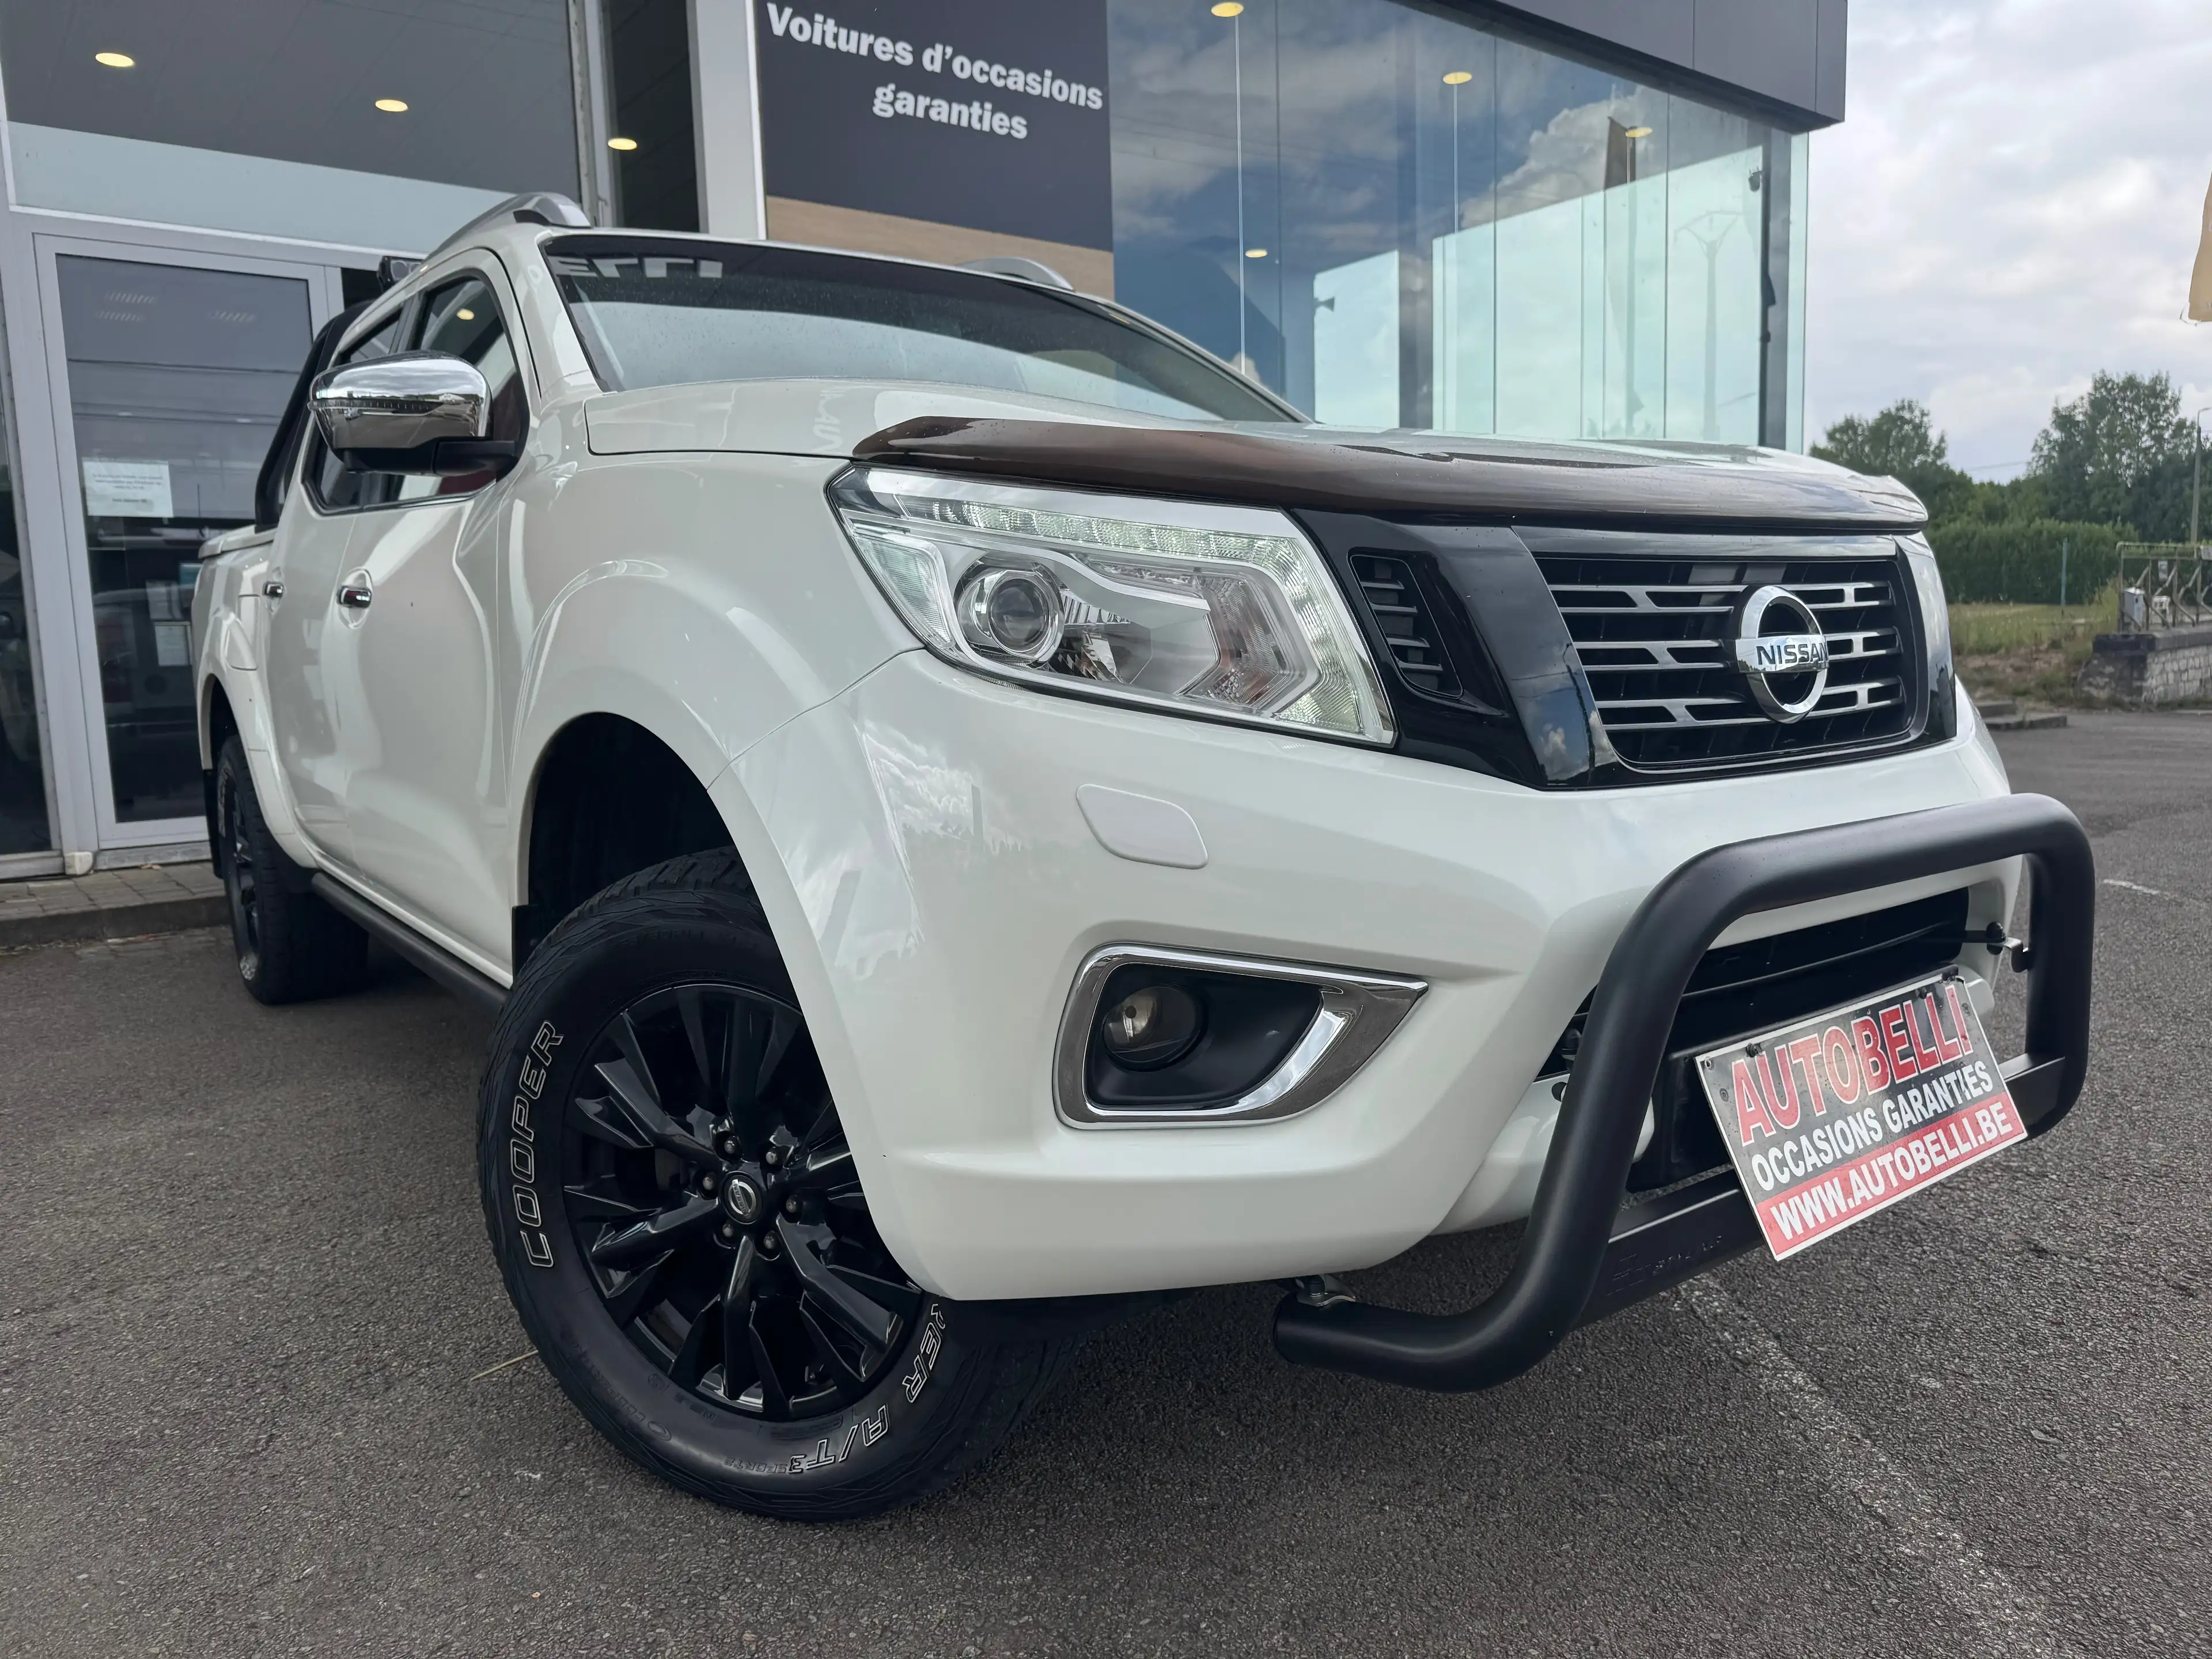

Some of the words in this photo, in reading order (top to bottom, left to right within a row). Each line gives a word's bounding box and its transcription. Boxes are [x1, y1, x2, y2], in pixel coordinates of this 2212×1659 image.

[767, 2, 914, 66] Voitures
[922, 43, 1103, 110] d’occasions
[872, 83, 1028, 139] garanties
[1756, 642, 1829, 666] NISSAN
[1730, 984, 1974, 1146] AUTOBELLI
[1752, 1106, 1884, 1191] OCCASIONS
[1882, 1060, 1993, 1134] GARANTIES
[510, 1020, 565, 1268] COOPER
[1770, 1101, 2013, 1240] WWW.AUTOBELLI.BE
